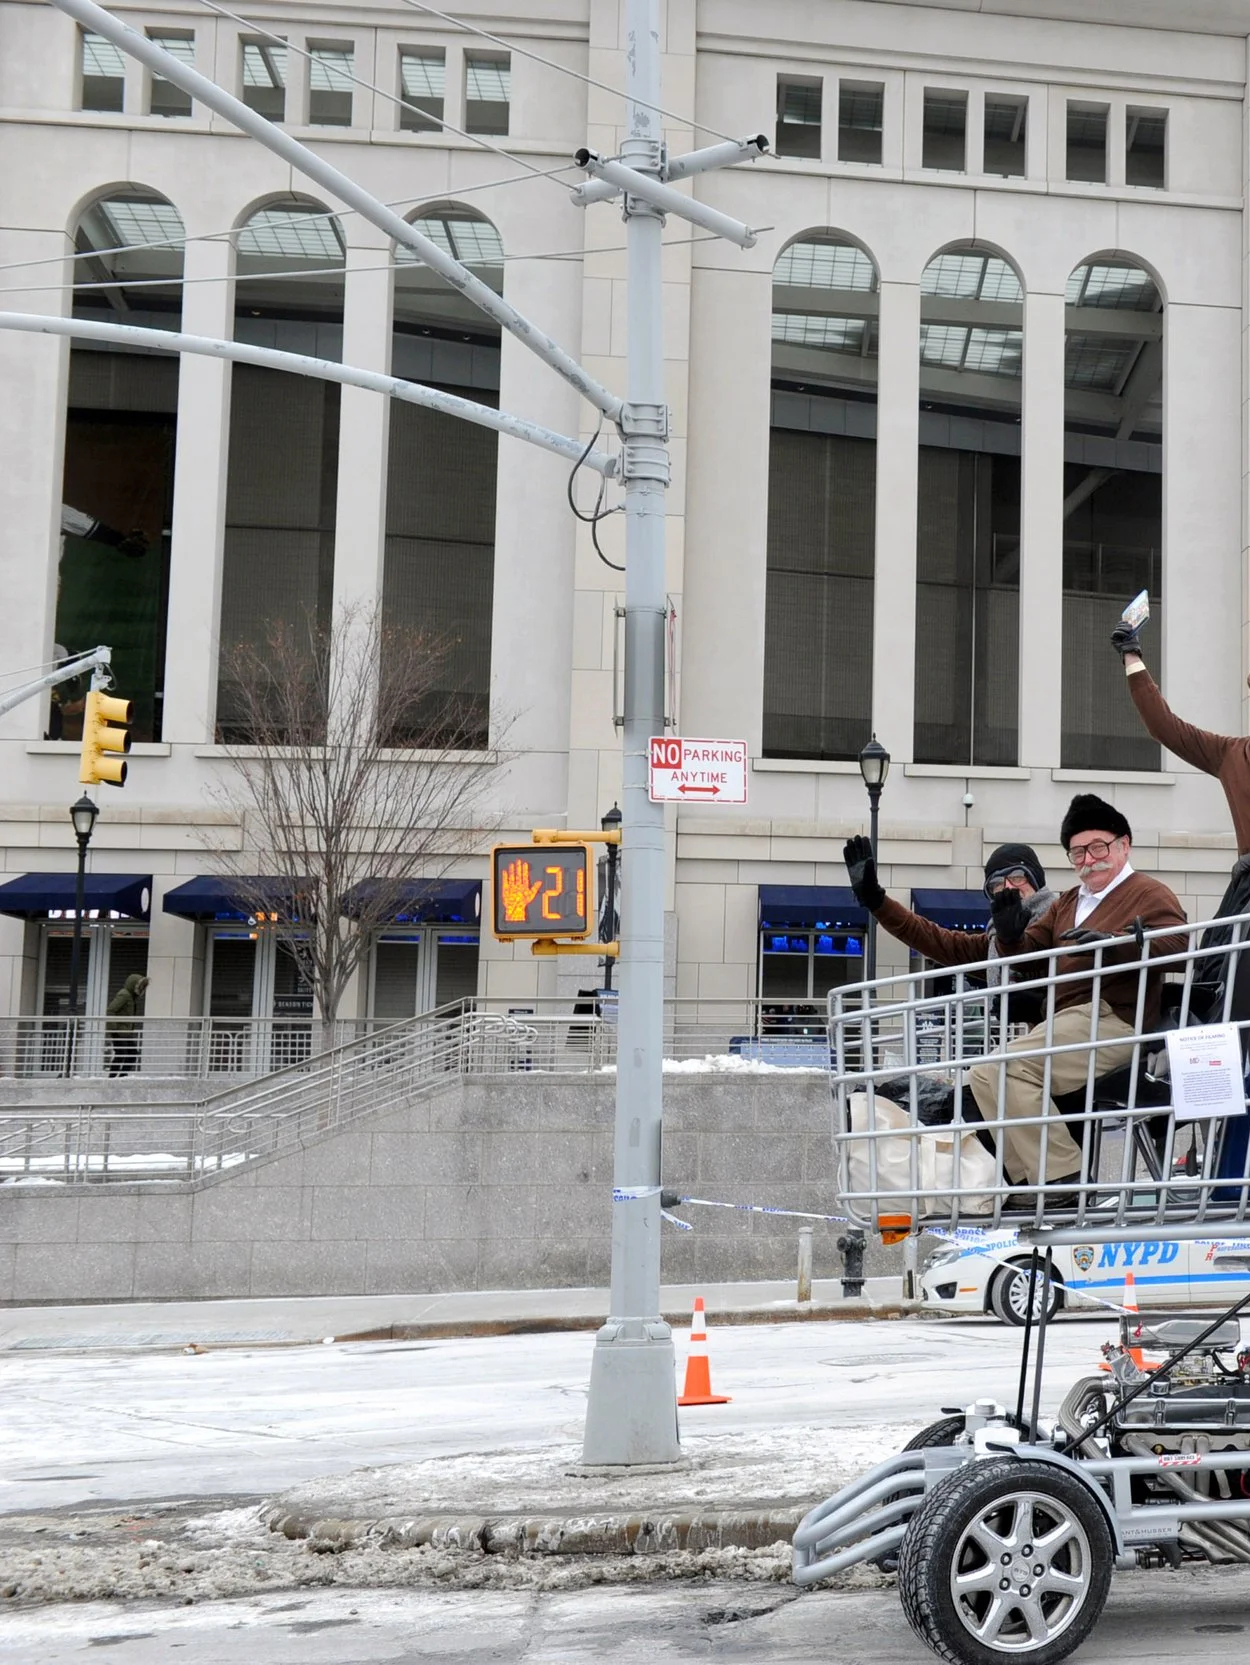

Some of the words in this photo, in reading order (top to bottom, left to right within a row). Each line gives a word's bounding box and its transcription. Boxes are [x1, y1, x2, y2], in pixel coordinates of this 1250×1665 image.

[653, 743, 680, 765] NO
[683, 749, 742, 762] PARKING
[671, 771, 728, 783] ANYTIME
[542, 866, 585, 919] 21
[1098, 1242, 1180, 1268] NYPD
